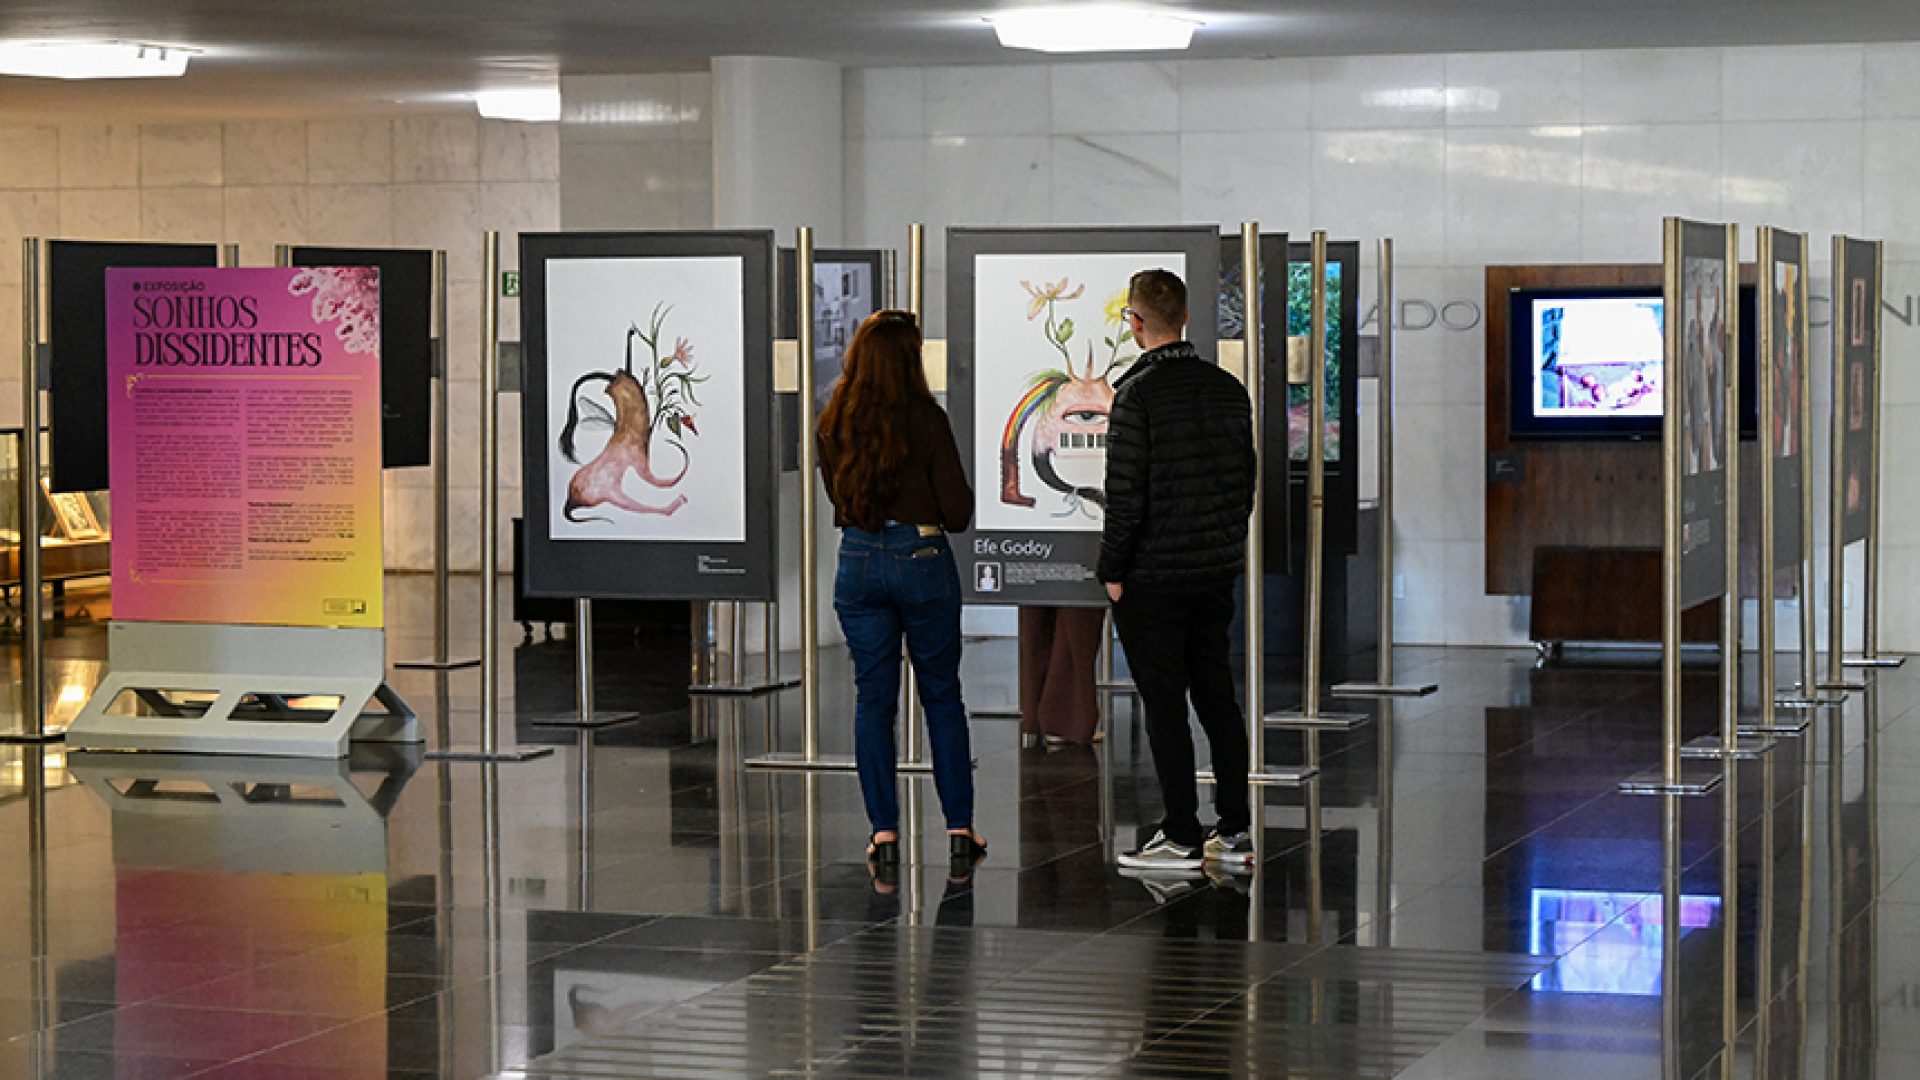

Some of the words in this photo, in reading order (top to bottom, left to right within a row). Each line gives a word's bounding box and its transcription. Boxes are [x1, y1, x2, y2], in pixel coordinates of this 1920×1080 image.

[144, 279, 206, 293] EXPOSIÇÃO
[133, 295, 258, 329] SONHOS
[134, 332, 322, 367] DISSIDENTES
[975, 539, 998, 555] Efe
[1001, 539, 1053, 559] Godoy
